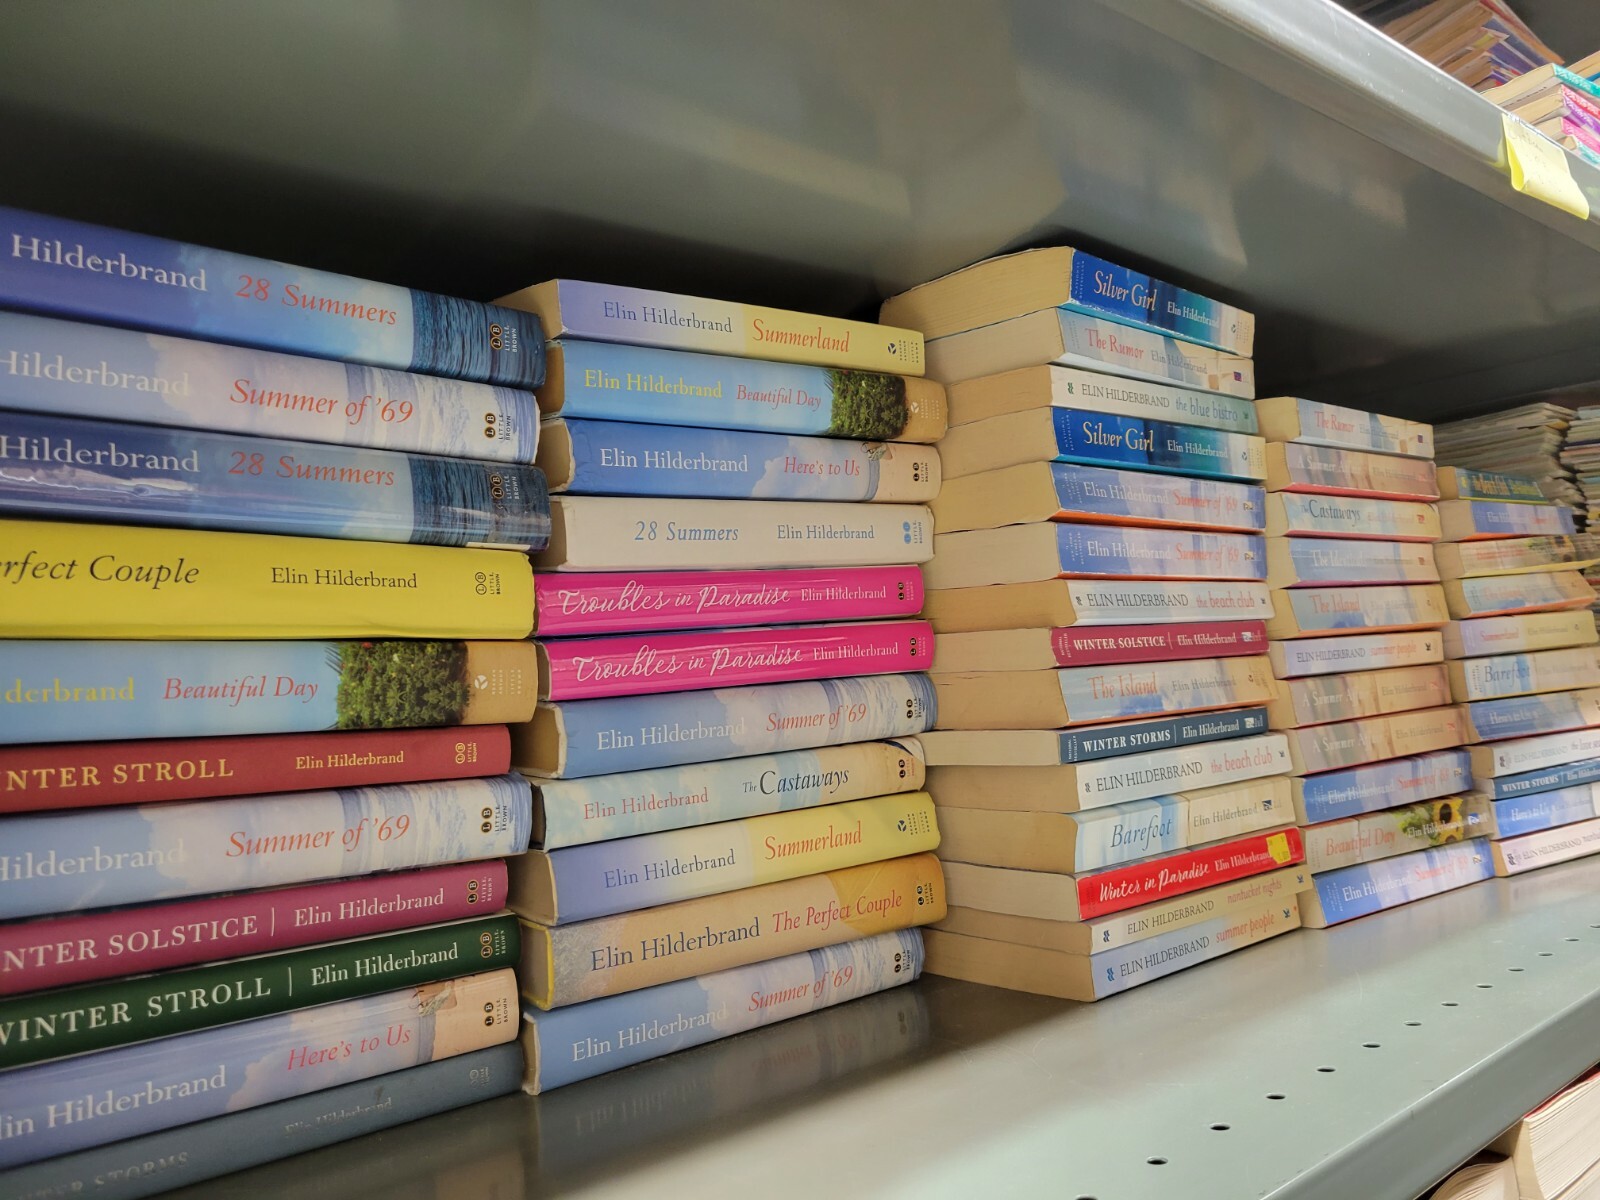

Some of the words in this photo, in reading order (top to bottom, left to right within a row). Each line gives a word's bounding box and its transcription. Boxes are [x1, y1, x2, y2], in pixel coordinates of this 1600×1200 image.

[12, 234, 208, 291] Hilderbrand
[235, 274, 270, 301] 28
[281, 284, 397, 325] Summers
[1093, 270, 1129, 302] Silver
[1131, 283, 1158, 311] Girl
[1167, 301, 1182, 316] Elin
[1183, 306, 1220, 328] Hilderbrand
[603, 301, 637, 321] Elin
[642, 306, 733, 333] Hilderbrand
[752, 318, 850, 353] Summerland
[1085, 327, 1107, 350] The
[1109, 334, 1145, 360] Rumor
[230, 378, 338, 415] Summer
[344, 395, 372, 424] of
[376, 398, 413, 424] '69
[584, 369, 620, 390] Elin
[626, 373, 723, 399] Hilderbrand
[736, 384, 792, 410] Beautiful
[796, 390, 822, 412] Day
[1082, 383, 1104, 398] ELIN
[1106, 388, 1170, 408] HILDERBRAND
[1175, 399, 1188, 412] the
[1190, 397, 1211, 417] blue
[1212, 403, 1238, 422] bistro
[0, 434, 201, 472] Hilderbrand
[228, 450, 264, 476] 28
[275, 455, 394, 487] Summers
[1083, 421, 1122, 447] Silver
[1125, 427, 1155, 452] Girl
[1167, 439, 1184, 452] Elin
[1185, 443, 1229, 459] Hilderbrand
[599, 447, 638, 468] Elin
[644, 449, 749, 473] Hilderbrand
[784, 456, 824, 475] Here's
[828, 462, 841, 475] to
[844, 459, 860, 477] Us
[1083, 481, 1107, 498] Elin
[1110, 484, 1169, 505] Hilderbrand
[1308, 499, 1361, 527] Castaways
[634, 520, 658, 541] 28
[666, 521, 739, 542] Summers
[777, 524, 803, 540] Elin
[806, 525, 875, 540] Hilderbrand
[0, 550, 78, 584] rfect
[89, 555, 200, 590] Couple
[271, 567, 309, 585] Elin
[314, 568, 418, 589] Hilderbrand
[557, 580, 671, 615] Troubles
[675, 592, 694, 606] in
[696, 584, 791, 614] Paradise
[800, 588, 822, 602] Elin
[826, 586, 887, 601] Hilderbrand
[1086, 593, 1114, 607] ELIN
[1116, 593, 1189, 607] HILDERBRAND
[1073, 638, 1117, 650] WINTER
[1118, 635, 1166, 649] SOLSTICE
[1177, 635, 1193, 646] Elin
[1193, 632, 1237, 645] Hilderbrand
[572, 645, 684, 682] Troubles
[688, 655, 707, 670] in
[709, 644, 803, 676] Paradise
[813, 647, 835, 661] Elin
[837, 642, 899, 659] Hilderbrand
[162, 675, 267, 707] Beautiful
[273, 677, 318, 703] Day
[1088, 675, 1116, 699] The
[1118, 672, 1158, 697] Island
[596, 729, 634, 751] Elin
[640, 717, 746, 746] Hilderbrand
[766, 712, 825, 732] Summer
[829, 705, 843, 730] of
[1083, 737, 1127, 753] WINTER
[1130, 730, 1171, 746] STORMS
[1182, 726, 1198, 739] Elin
[1199, 719, 1240, 737] Hilderbrand
[0, 766, 101, 791] NTER
[112, 758, 234, 784] STROLL
[295, 757, 323, 770] Elin
[327, 751, 404, 768] Hilderbrand
[1096, 776, 1126, 792] ELIN
[1127, 761, 1203, 787] HILDERBRAND
[1210, 760, 1223, 774] the
[1224, 752, 1252, 771] beach
[1253, 747, 1273, 766] club
[583, 802, 616, 820] Elin
[622, 786, 709, 814] Hilderbrand
[742, 781, 757, 794] The
[759, 768, 850, 795] Castaways
[225, 830, 335, 857] Summer
[341, 817, 369, 852] of
[372, 814, 411, 842] '69
[1110, 814, 1173, 851] Barefoot
[1193, 814, 1211, 828] Elin
[1212, 805, 1258, 824] Hilderbrand
[1375, 828, 1396, 848] Day
[603, 868, 639, 889] Elin
[643, 848, 736, 881] Hilderbrand
[764, 820, 862, 860] Summerland
[1099, 880, 1141, 902] Winter
[1144, 876, 1157, 890] in
[1158, 862, 1211, 892] Paradise
[1214, 859, 1230, 872] Elin
[1230, 850, 1271, 869] Hilderbran
[1342, 886, 1362, 902] Elin
[108, 915, 258, 957] SOLSTICE
[294, 905, 332, 927] Elin
[339, 888, 444, 920] Hilderbrand
[591, 946, 634, 972] Elin
[640, 916, 760, 961] Hilderbrand
[772, 911, 801, 933] The
[805, 900, 851, 931] Perfect
[856, 889, 903, 918] Couple
[1127, 920, 1149, 935] ELIN
[1151, 900, 1215, 929] HILDERBRAND
[1120, 961, 1143, 977] ELIN
[1145, 935, 1210, 969] HILDERBRAND
[1216, 925, 1247, 944] summer
[1249, 909, 1275, 934] people
[147, 977, 271, 1017] STROLL
[311, 965, 348, 986] Elin
[355, 942, 458, 978] Hilderbrand
[572, 1037, 611, 1062] Elin
[618, 1001, 728, 1049] Hilderbrand
[748, 983, 810, 1012] Summer
[813, 972, 829, 998] of
[47, 1064, 226, 1129] Hilderbrand
[287, 1040, 352, 1070] Here's
[360, 1034, 380, 1054] to
[387, 1024, 411, 1047] Us
